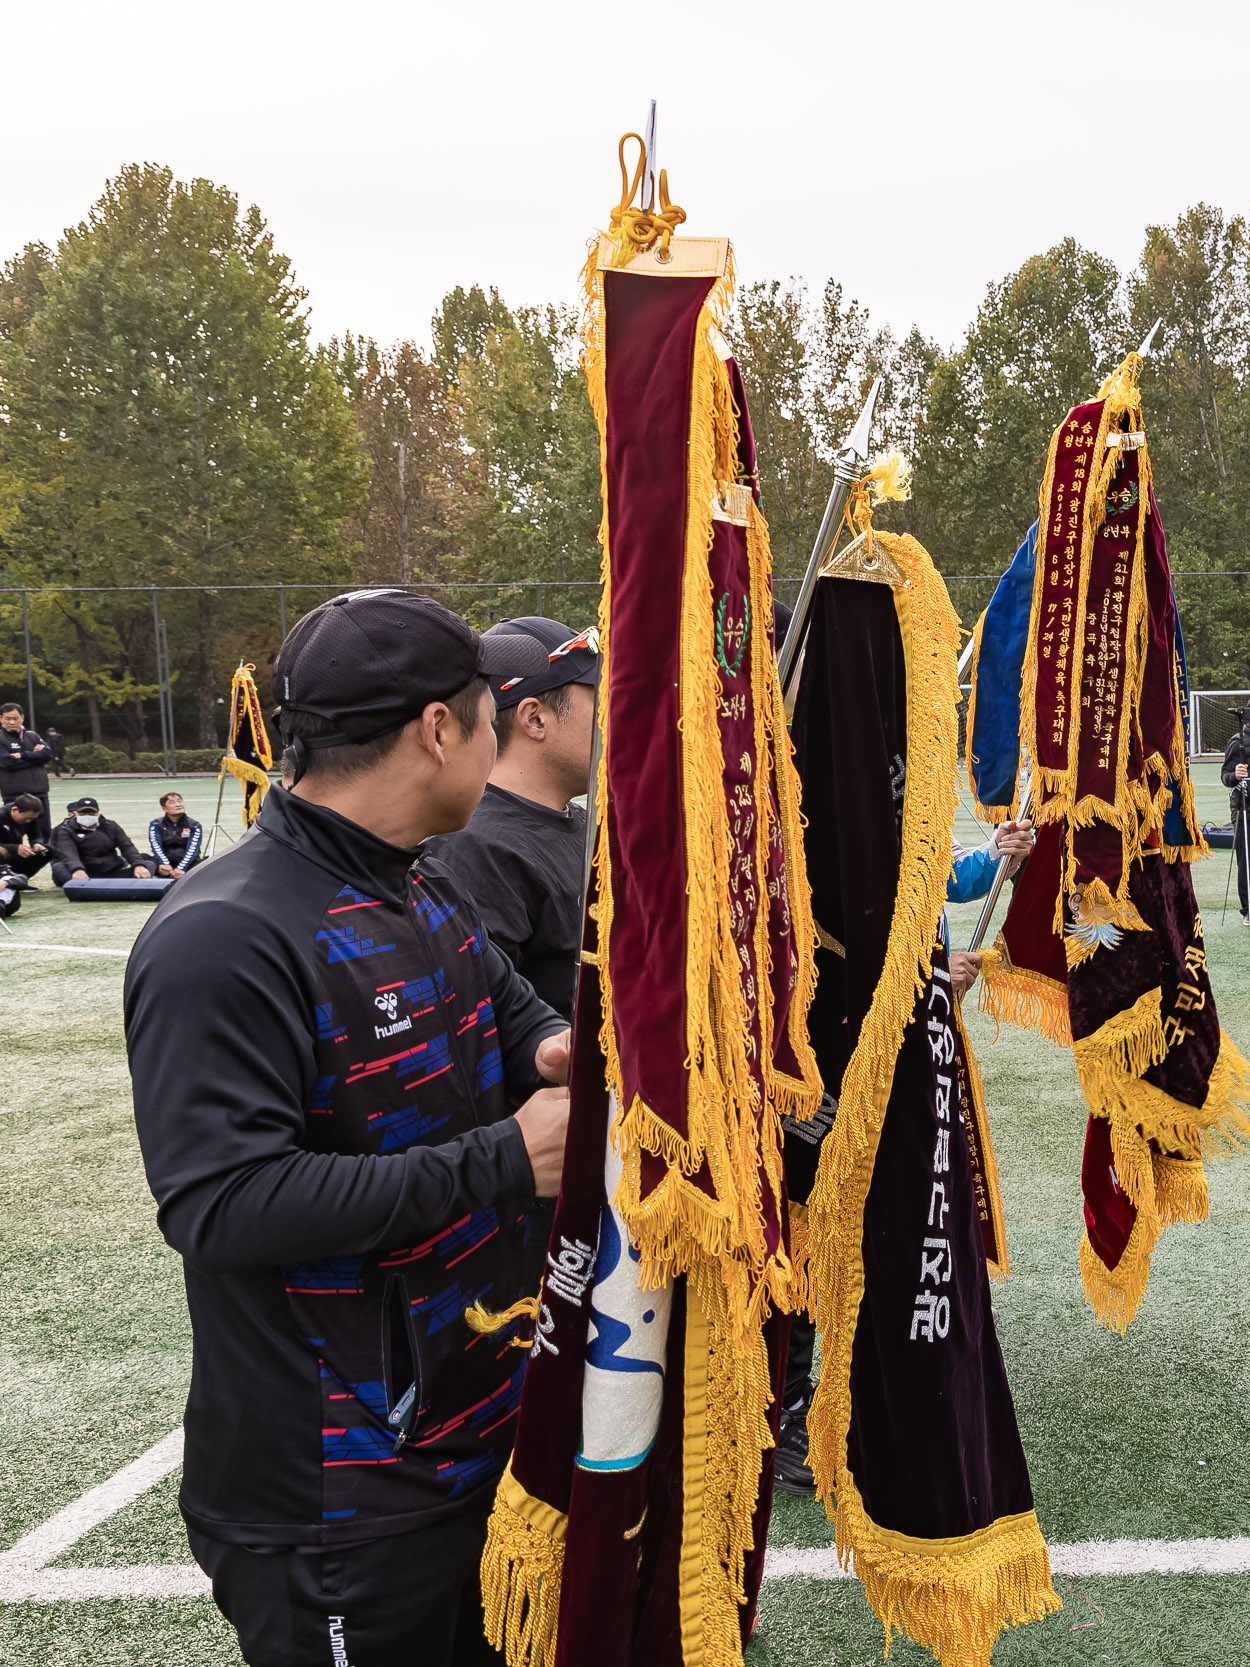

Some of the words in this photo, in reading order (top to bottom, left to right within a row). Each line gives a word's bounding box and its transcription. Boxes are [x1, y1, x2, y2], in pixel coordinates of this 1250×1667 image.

[1067, 420, 1093, 434] 우승
[1063, 434, 1094, 448] 청년부
[1106, 487, 1132, 503] 우승
[723, 616, 744, 649] 우승
[720, 693, 746, 720] 노장부
[374, 1015, 413, 1040] hummel
[328, 1615, 355, 1667] humme
